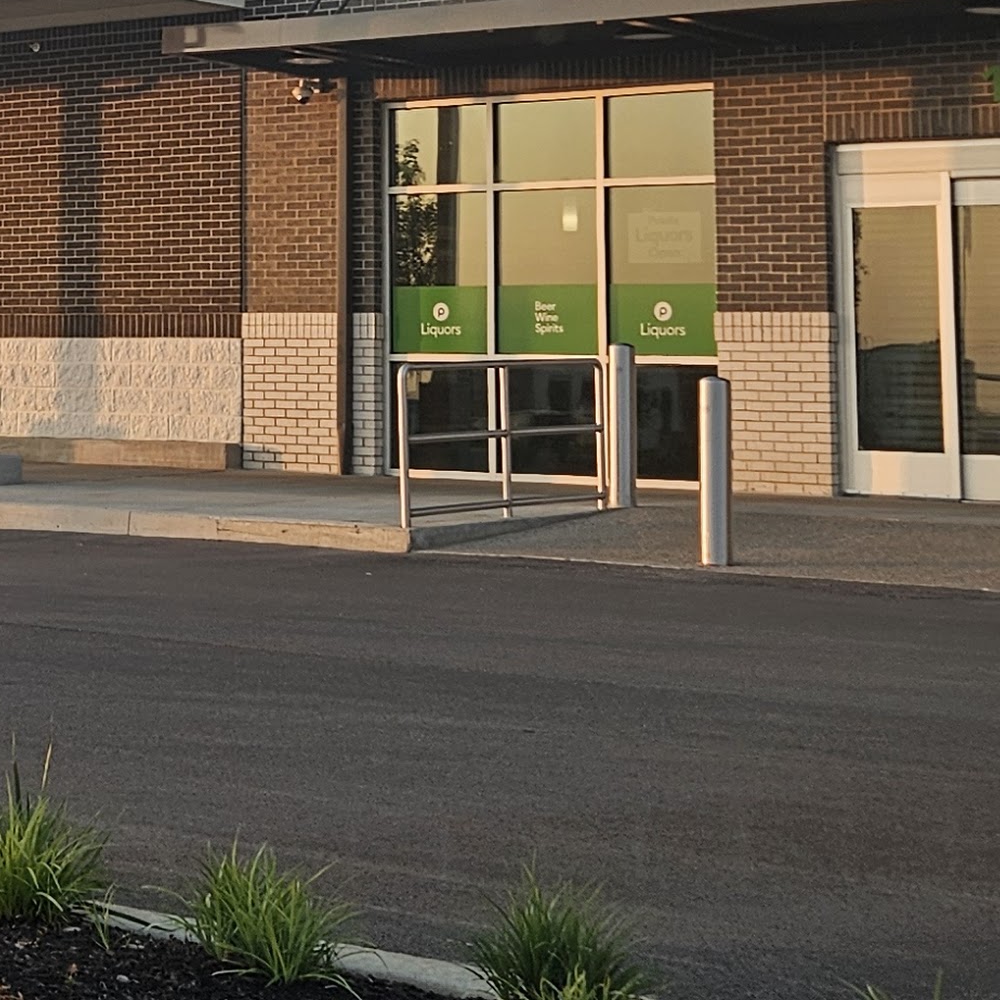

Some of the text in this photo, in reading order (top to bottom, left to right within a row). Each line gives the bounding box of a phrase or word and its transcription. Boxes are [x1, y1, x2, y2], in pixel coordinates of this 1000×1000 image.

[535, 301, 556, 311] Beer
[534, 312, 559, 322] Wine
[420, 322, 462, 339] Liquors
[535, 323, 564, 336] Spirits
[640, 322, 686, 340] Liquors
